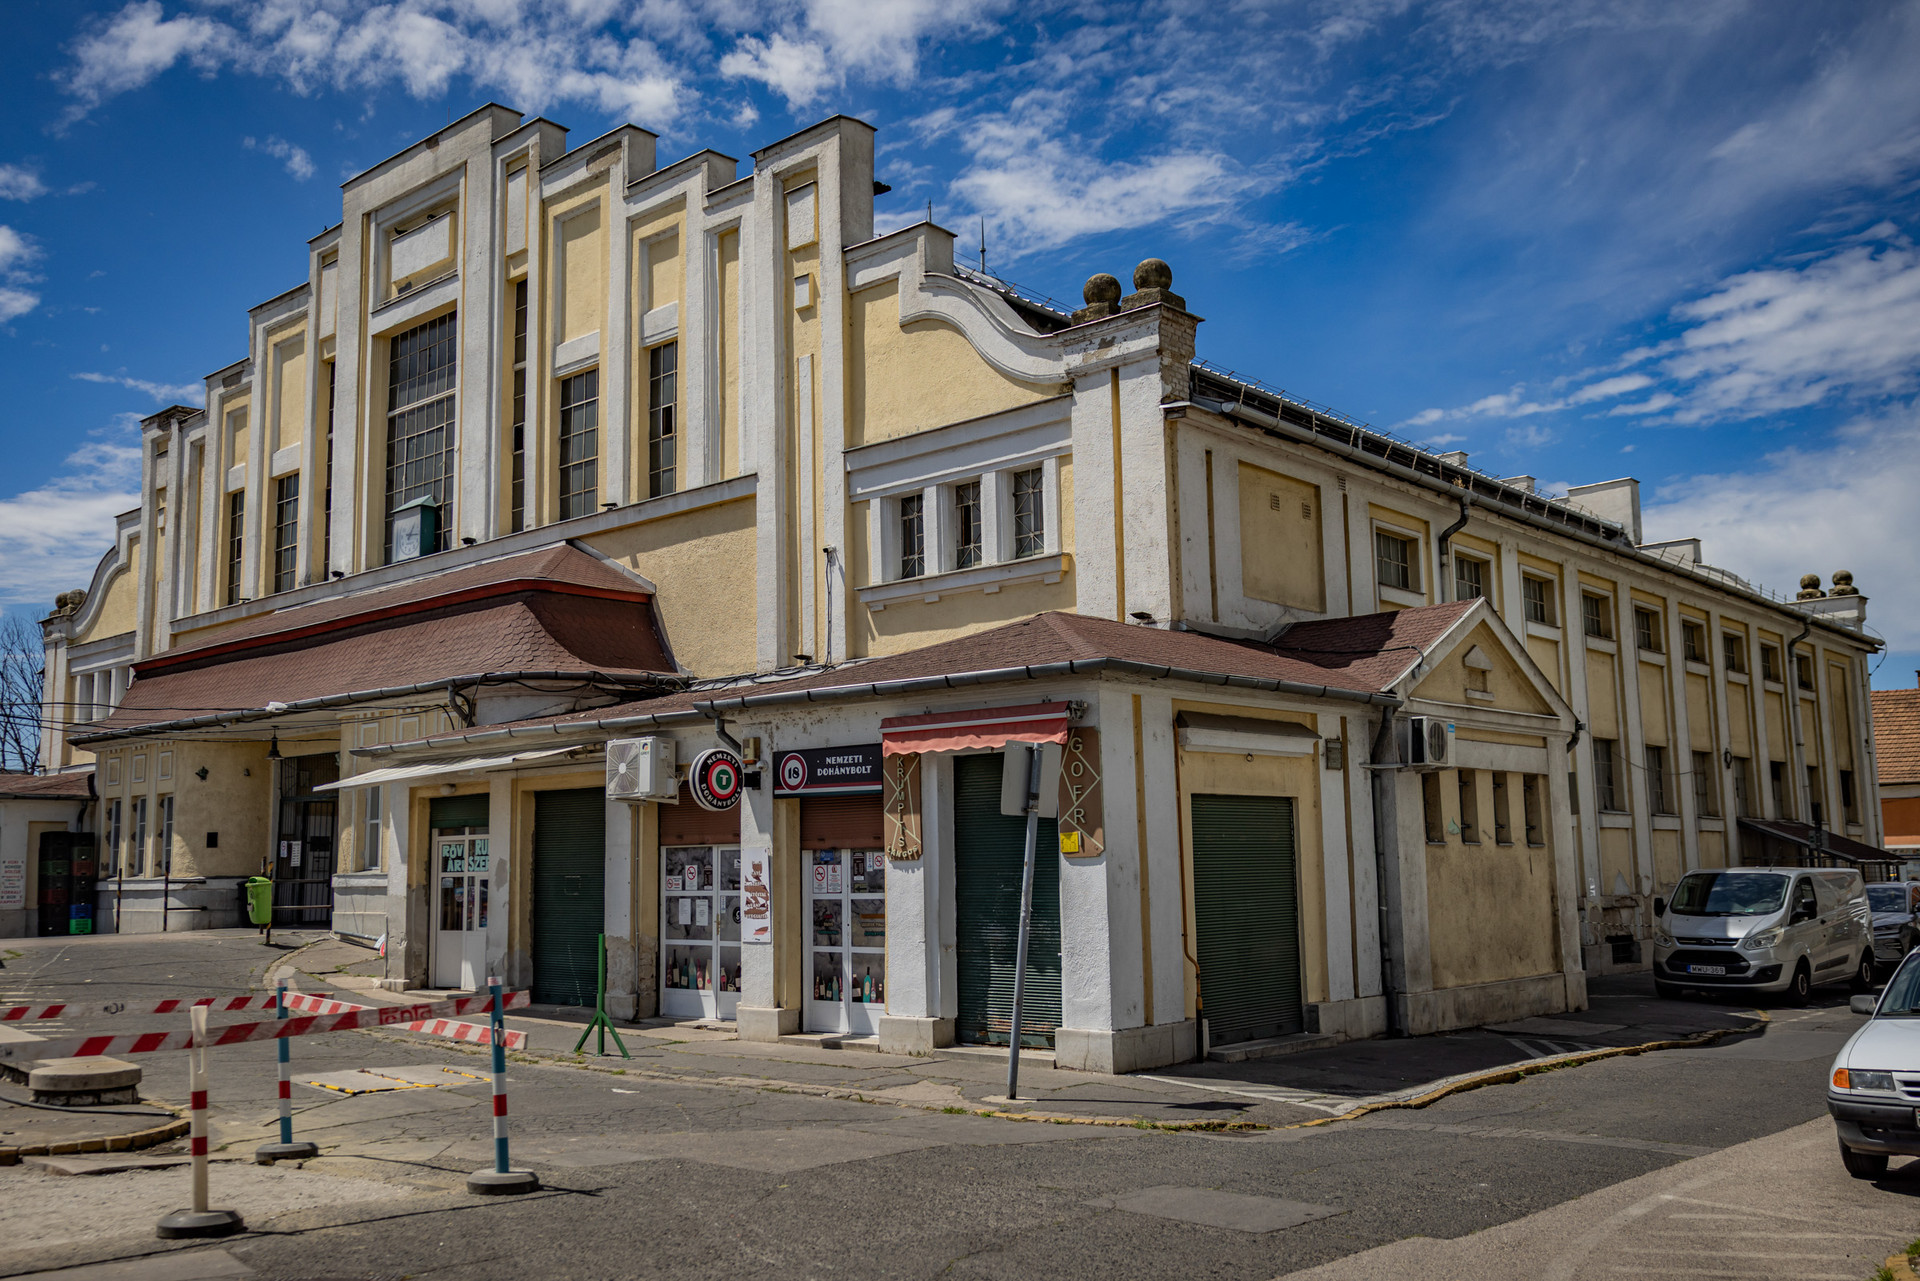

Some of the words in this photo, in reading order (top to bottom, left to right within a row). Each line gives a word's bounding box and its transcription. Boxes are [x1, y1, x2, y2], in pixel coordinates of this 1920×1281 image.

[707, 753, 738, 767] NEMZETI
[825, 755, 862, 765] NEMZETI
[788, 766, 800, 779] 18
[817, 765, 872, 777] DOHÁNYBOLT
[720, 774, 729, 786] T
[701, 783, 741, 807] DOHÁNYBOLT
[442, 844, 465, 859] RÖV
[475, 839, 489, 855] RU
